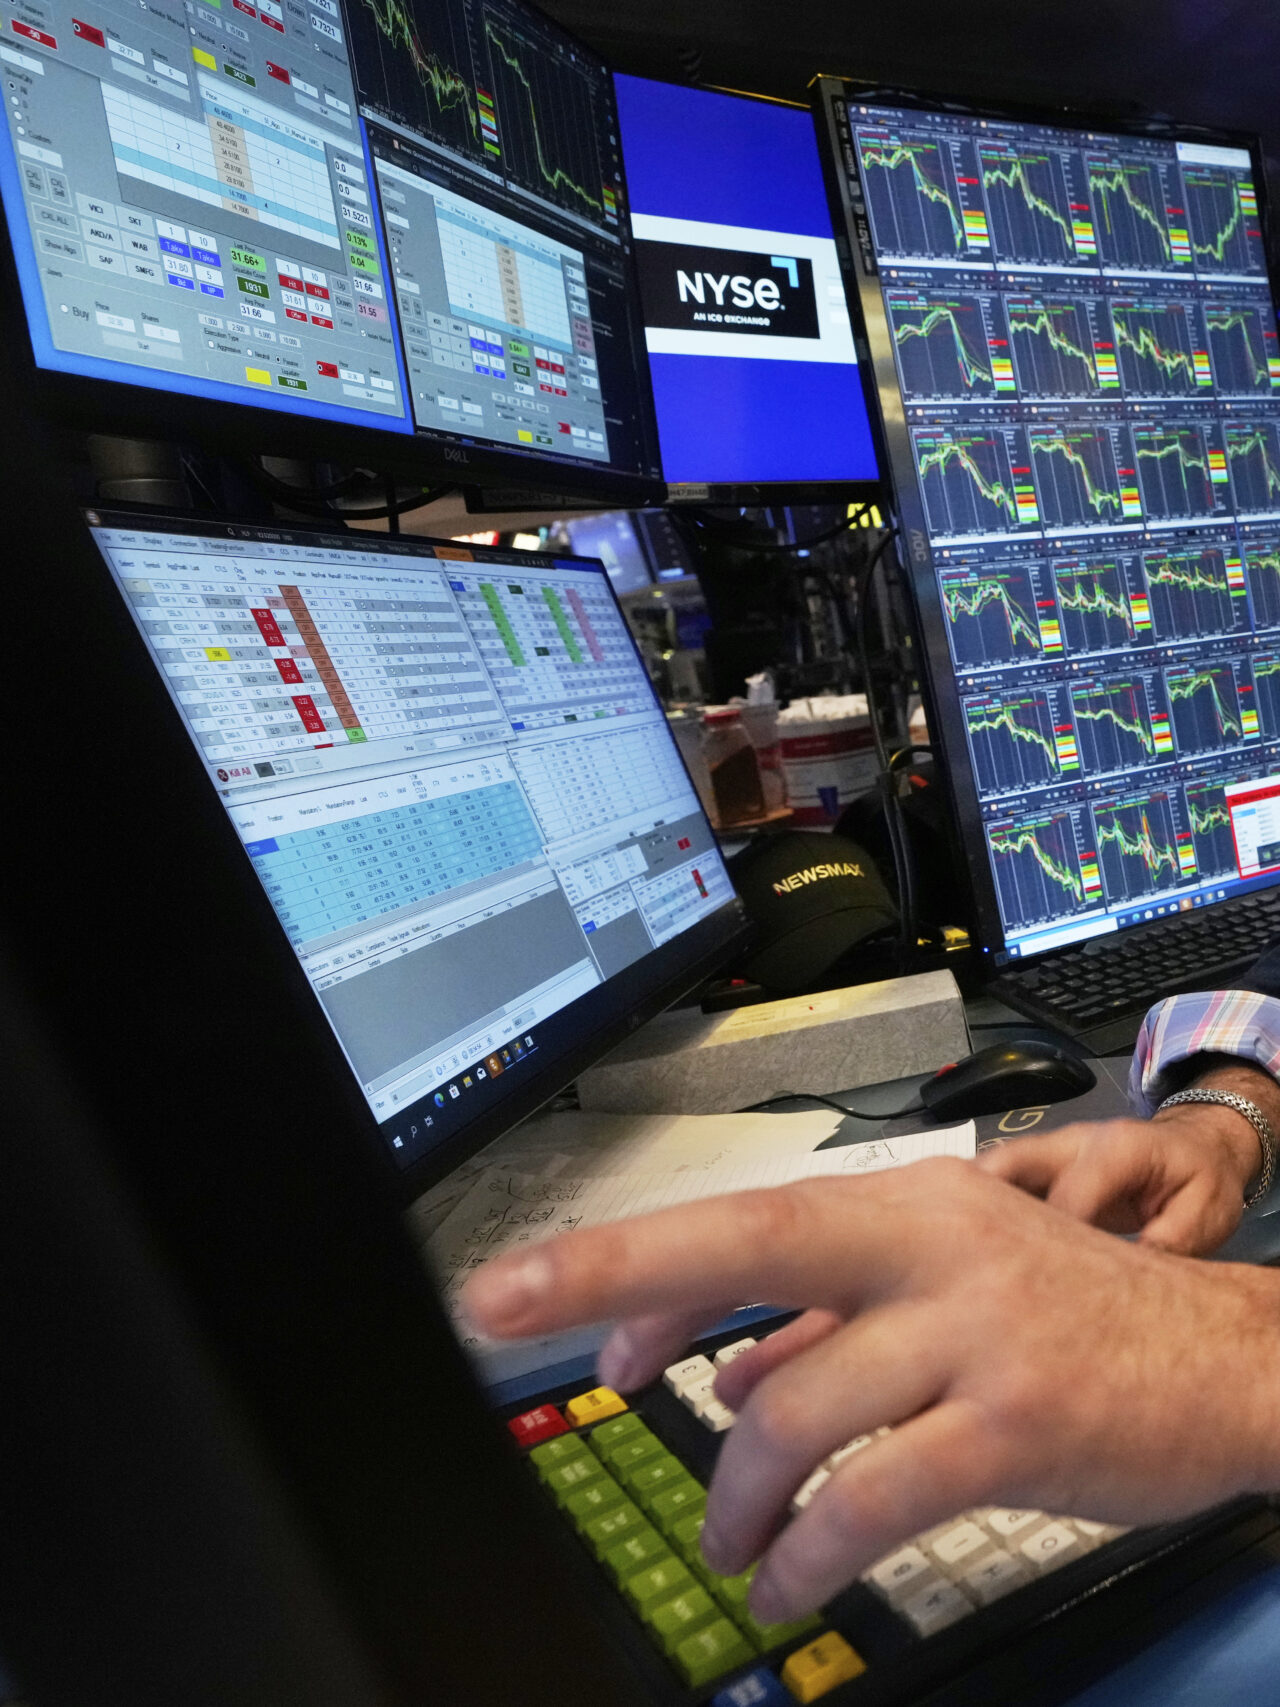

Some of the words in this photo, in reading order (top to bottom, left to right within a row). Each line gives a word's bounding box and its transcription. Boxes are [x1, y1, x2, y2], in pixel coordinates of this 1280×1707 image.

[311, 17, 335, 36] 0.7321
[335, 161, 346, 172] 0.0
[338, 184, 350, 195] 0.0
[128, 216, 141, 226] SKT
[342, 207, 368, 225] 31.5221
[169, 227, 173, 235] 1
[200, 237, 208, 246] 10
[347, 233, 367, 247] 0.13%
[132, 241, 148, 251] WAB
[166, 242, 183, 254] Take
[99, 256, 113, 264] SAP
[198, 252, 214, 263] Take
[232, 250, 259, 266] 31.66+
[350, 255, 365, 266] 0.04
[136, 266, 154, 276] SMFG
[245, 282, 262, 294] 1931
[354, 280, 373, 292] 31.66
[677, 270, 780, 311] NYSE
[336, 297, 352, 308] Down
[73, 306, 89, 321] Buy
[359, 304, 377, 317] 31.55
[141, 312, 159, 323] Shares
[694, 312, 705, 321] AN
[707, 314, 722, 322] ICE
[724, 315, 770, 326] EXCHANGE
[228, 333, 239, 342] Type
[772, 863, 864, 896] NEWSMAX
[682, 1365, 696, 1374] 3
